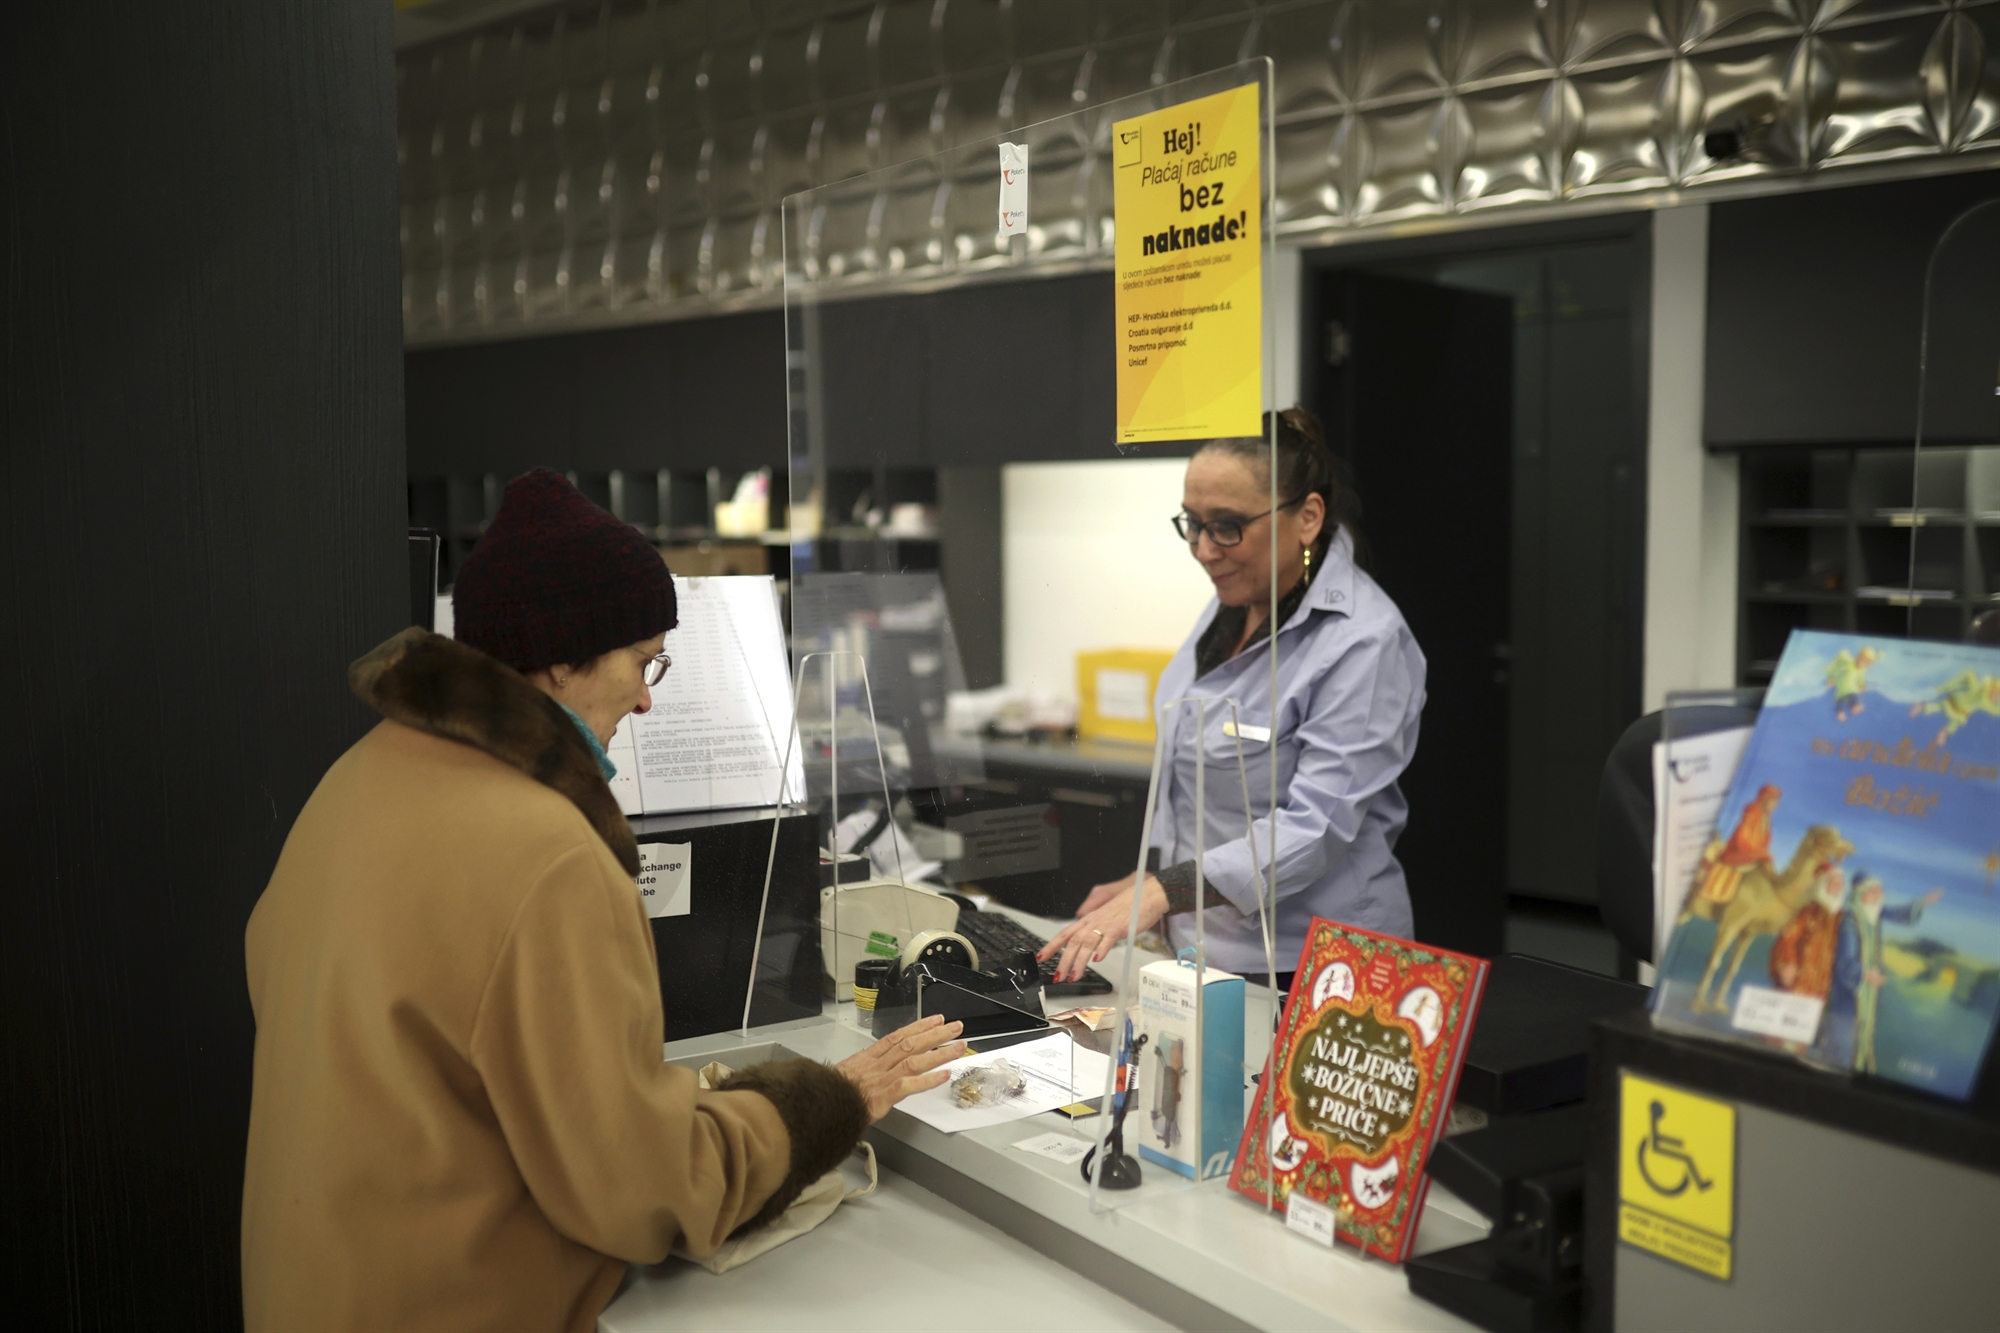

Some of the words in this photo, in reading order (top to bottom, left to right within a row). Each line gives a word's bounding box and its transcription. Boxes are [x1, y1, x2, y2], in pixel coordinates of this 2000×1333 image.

[1163, 122, 1201, 155] Hej!
[1142, 158, 1184, 188] Plaćaj
[1186, 150, 1237, 176] račune
[1180, 181, 1224, 213] bez
[1142, 210, 1246, 257] naknade!
[1128, 270, 1142, 278] ovom
[1164, 275, 1174, 284] bez
[1143, 309, 1168, 321] Hrvatska
[1170, 303, 1218, 318] elektroprivreda
[1128, 327, 1149, 338] Croatia
[1150, 323, 1181, 336] osiguranje
[1128, 343, 1156, 352] Posmrtna
[1158, 338, 1187, 350] pripomoć
[1128, 357, 1148, 367] Unicef
[640, 862, 682, 872] xchange
[635, 876, 656, 885] lute
[1310, 1036, 1419, 1091] NAJLJEPŠE
[1314, 1065, 1400, 1114] BOŽIĆNE
[1318, 1096, 1378, 1137] PRIČE
